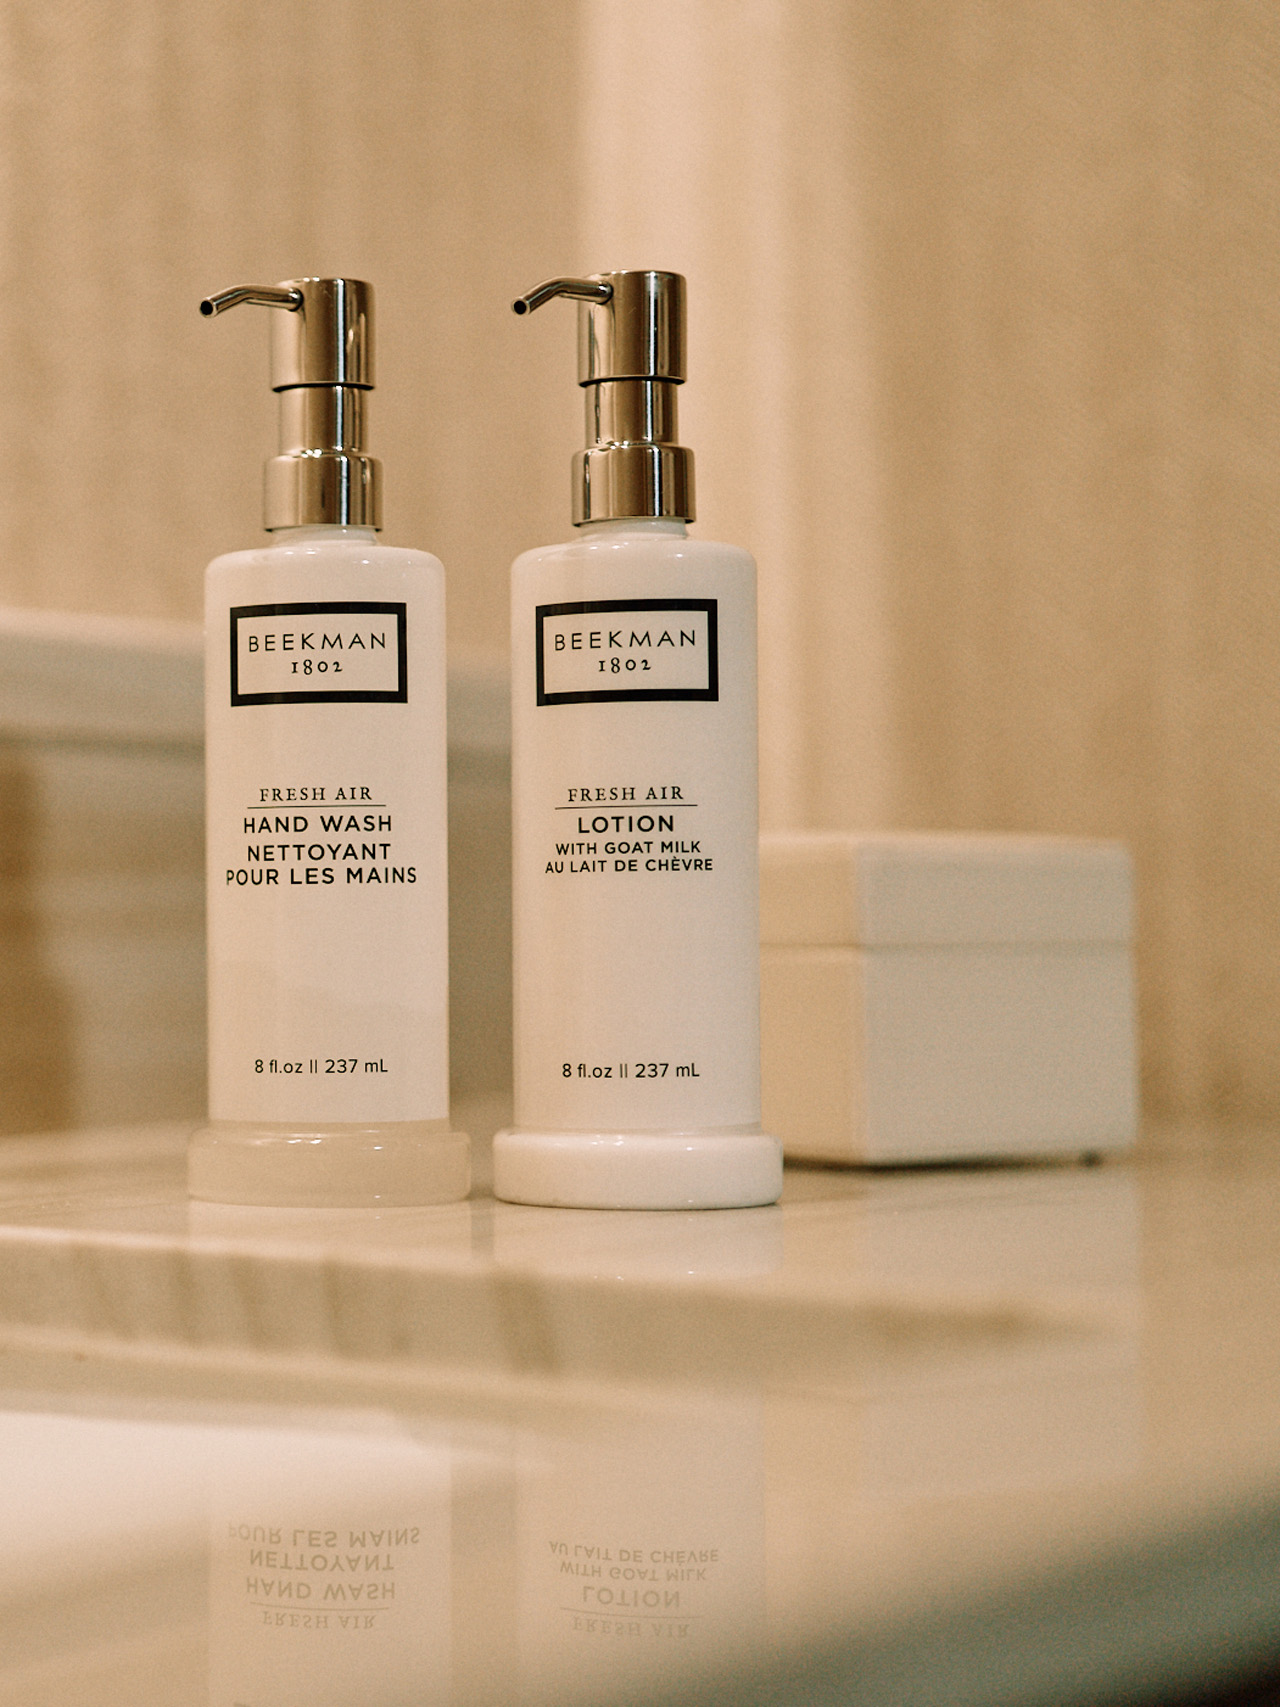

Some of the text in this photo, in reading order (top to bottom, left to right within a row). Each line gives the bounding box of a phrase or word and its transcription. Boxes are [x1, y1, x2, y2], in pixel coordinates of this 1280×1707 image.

[248, 632, 386, 653] BEEKMAN
[554, 629, 696, 651] BEEKMAN
[291, 659, 343, 675] 1802
[598, 657, 652, 674] 1802
[259, 786, 373, 802] FRESH AIR
[568, 785, 684, 802] FRESH AIR
[244, 815, 392, 834] HAND WASH
[578, 815, 674, 834] LOTION
[247, 843, 391, 862] NETTOYANT
[555, 840, 701, 856] WITH GOAT MILK
[545, 856, 713, 874] AU LAIT DE CHÈVRE
[226, 866, 417, 886] POUR LES MAINS
[254, 1058, 264, 1074] 8
[325, 1058, 358, 1074] 237
[364, 1058, 388, 1073] mL
[562, 1063, 572, 1078] 8
[635, 1063, 669, 1078] 237
[676, 1062, 700, 1077] mL
